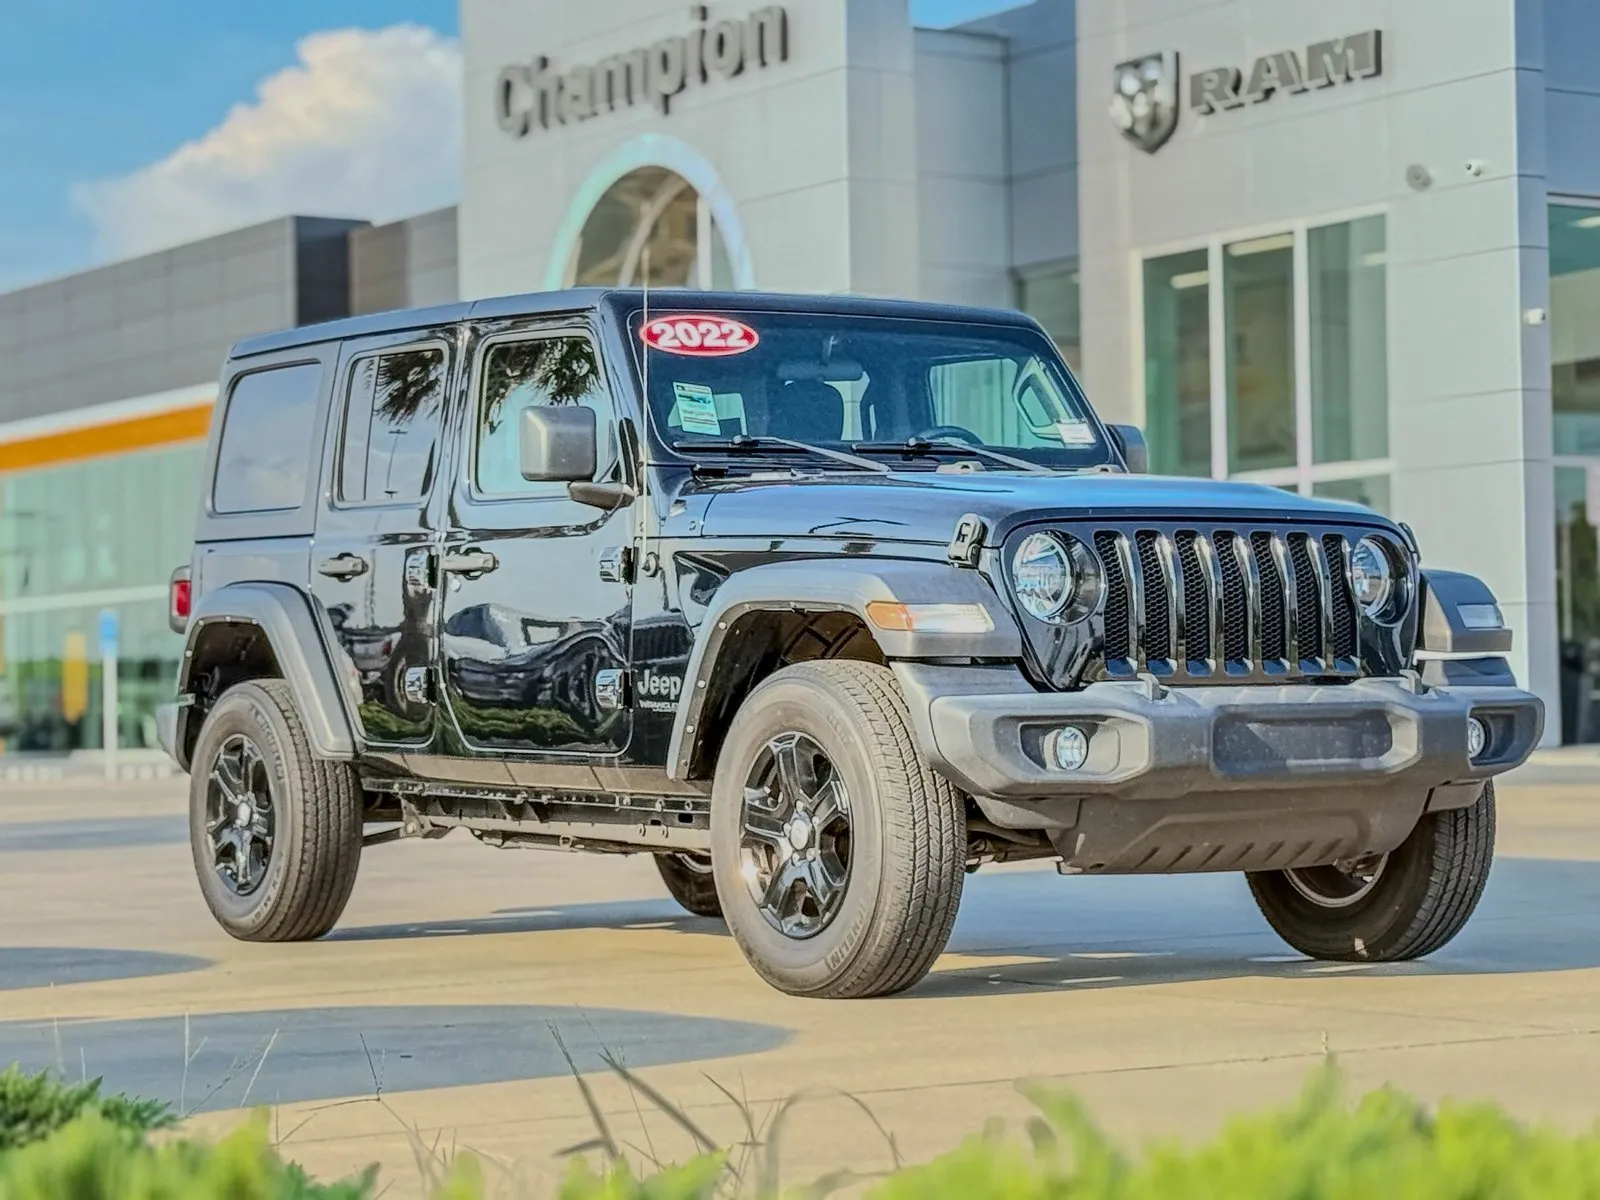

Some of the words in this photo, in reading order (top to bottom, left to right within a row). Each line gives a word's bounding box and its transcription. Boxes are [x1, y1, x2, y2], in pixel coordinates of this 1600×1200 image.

[498, 4, 789, 137] Champion
[1190, 30, 1382, 116] RAM
[651, 321, 749, 348] 2022
[637, 669, 681, 700] Jeep
[639, 699, 680, 709] WRANGLE
